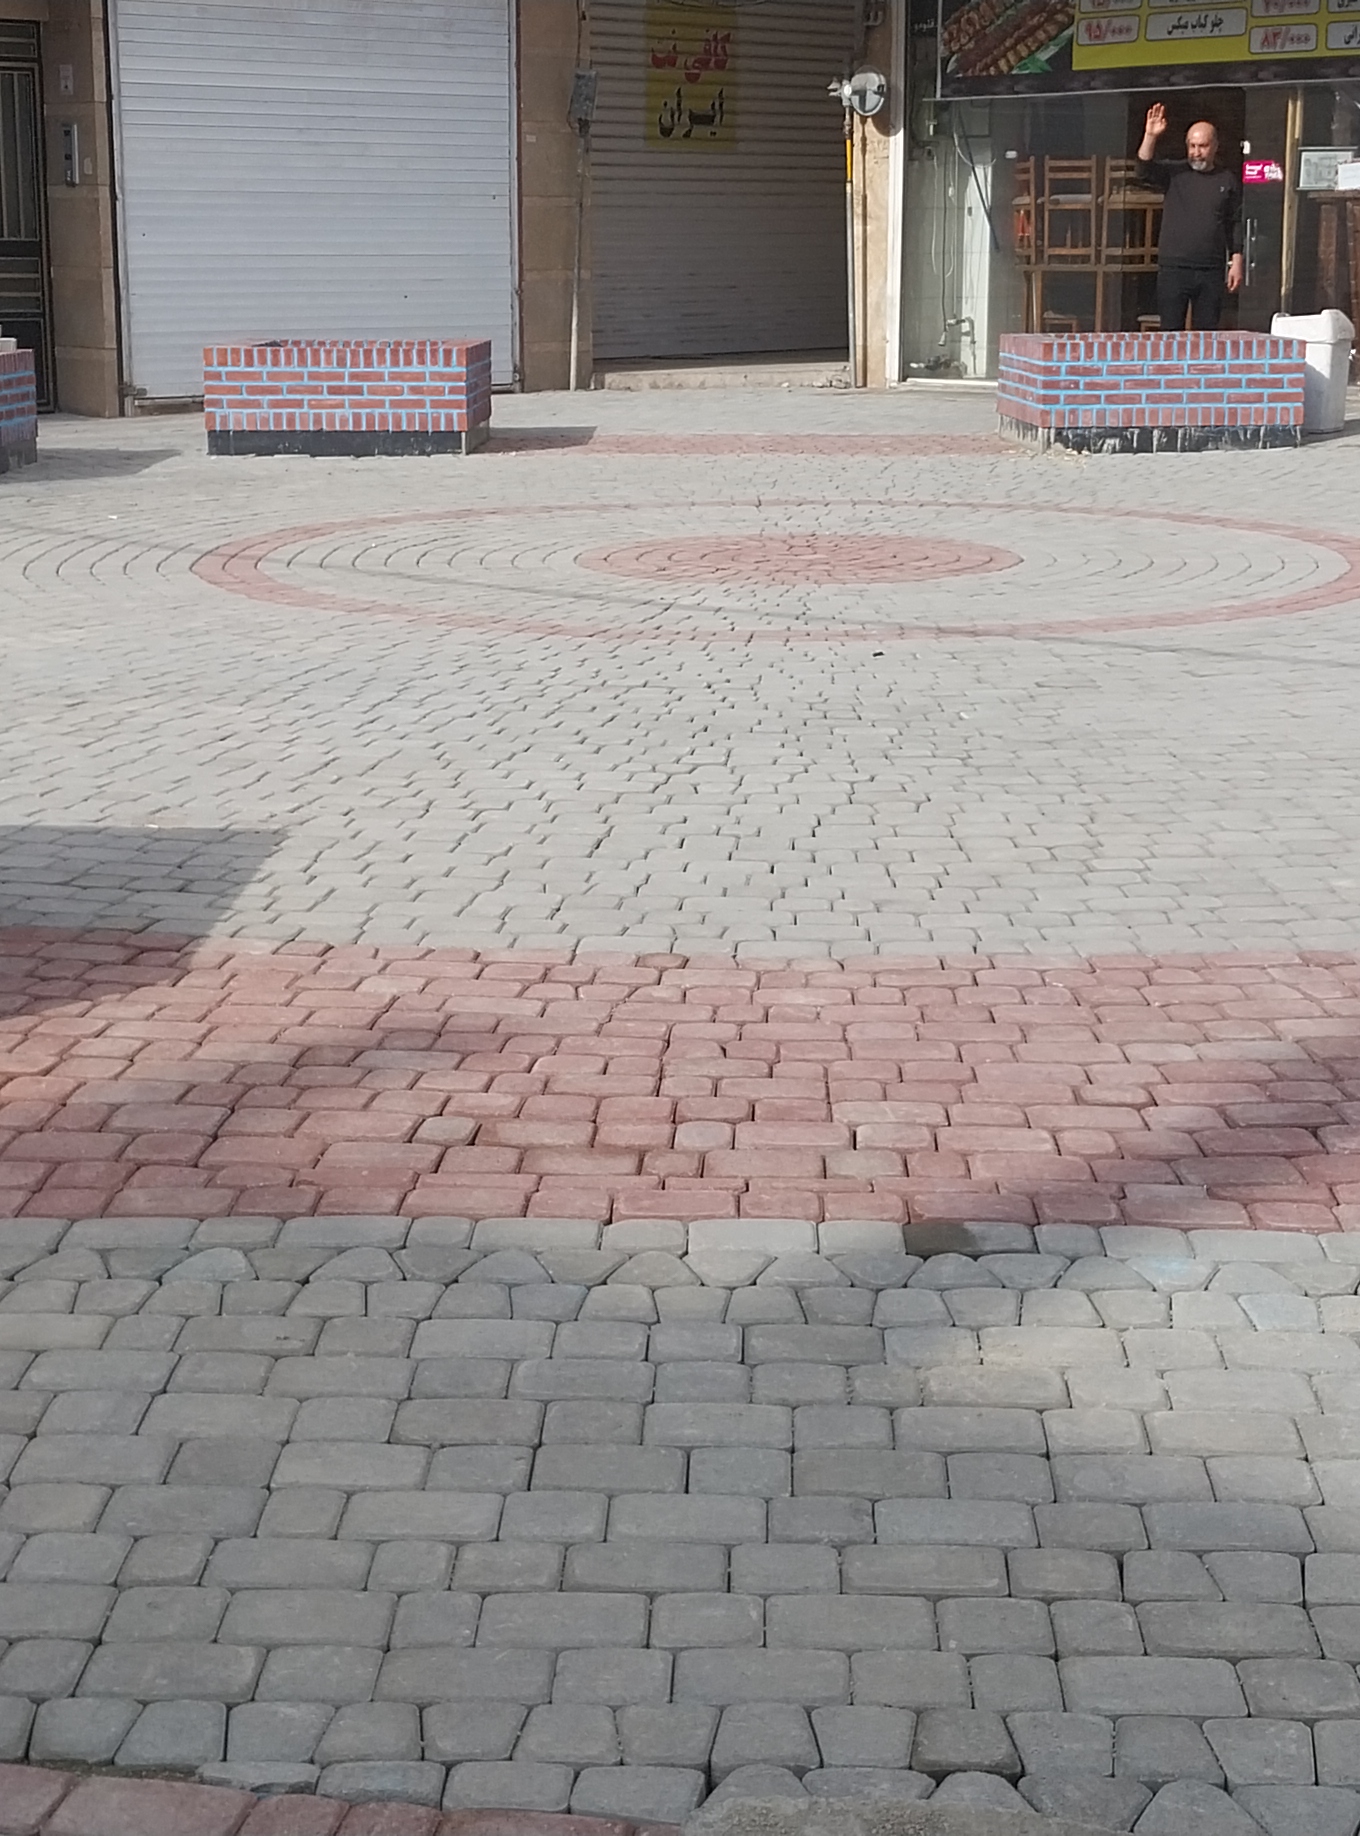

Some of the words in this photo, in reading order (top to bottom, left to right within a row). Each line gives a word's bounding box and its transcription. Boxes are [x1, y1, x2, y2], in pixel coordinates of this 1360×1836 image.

[1167, 16, 1190, 35] میکس
[1191, 14, 1209, 33] کباب
[1210, 14, 1224, 33] چلو
[650, 28, 679, 69] نت
[684, 29, 731, 84] کافی
[658, 86, 725, 138] ایران
